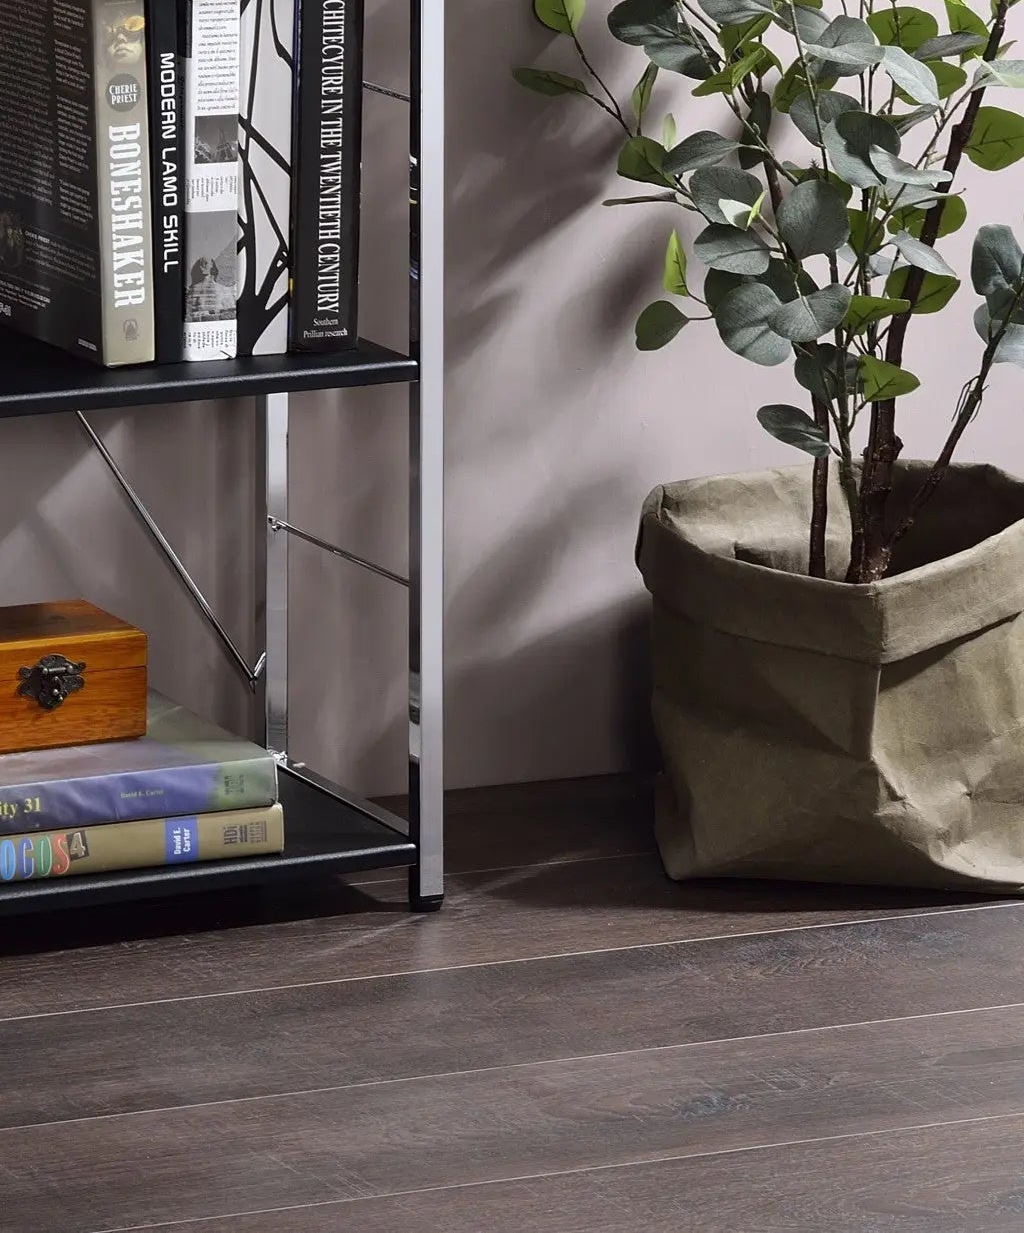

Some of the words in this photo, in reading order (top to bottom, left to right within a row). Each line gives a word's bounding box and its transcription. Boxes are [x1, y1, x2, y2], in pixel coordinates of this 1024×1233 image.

[108, 83, 138, 95] CHERIE
[111, 93, 138, 105] PRIEST
[159, 51, 177, 140] MODERN
[320, 99, 344, 115] IN
[320, 119, 344, 148] THE
[318, 151, 343, 240] TWENTIETH
[109, 122, 146, 308] BONESHAKER
[163, 214, 179, 274] SKILL
[317, 242, 341, 313] CENTURY
[313, 317, 339, 327] Southern
[325, 328, 348, 337] research
[23, 796, 42, 813] 31
[173, 833, 182, 855] David
[182, 828, 191, 853] Carter
